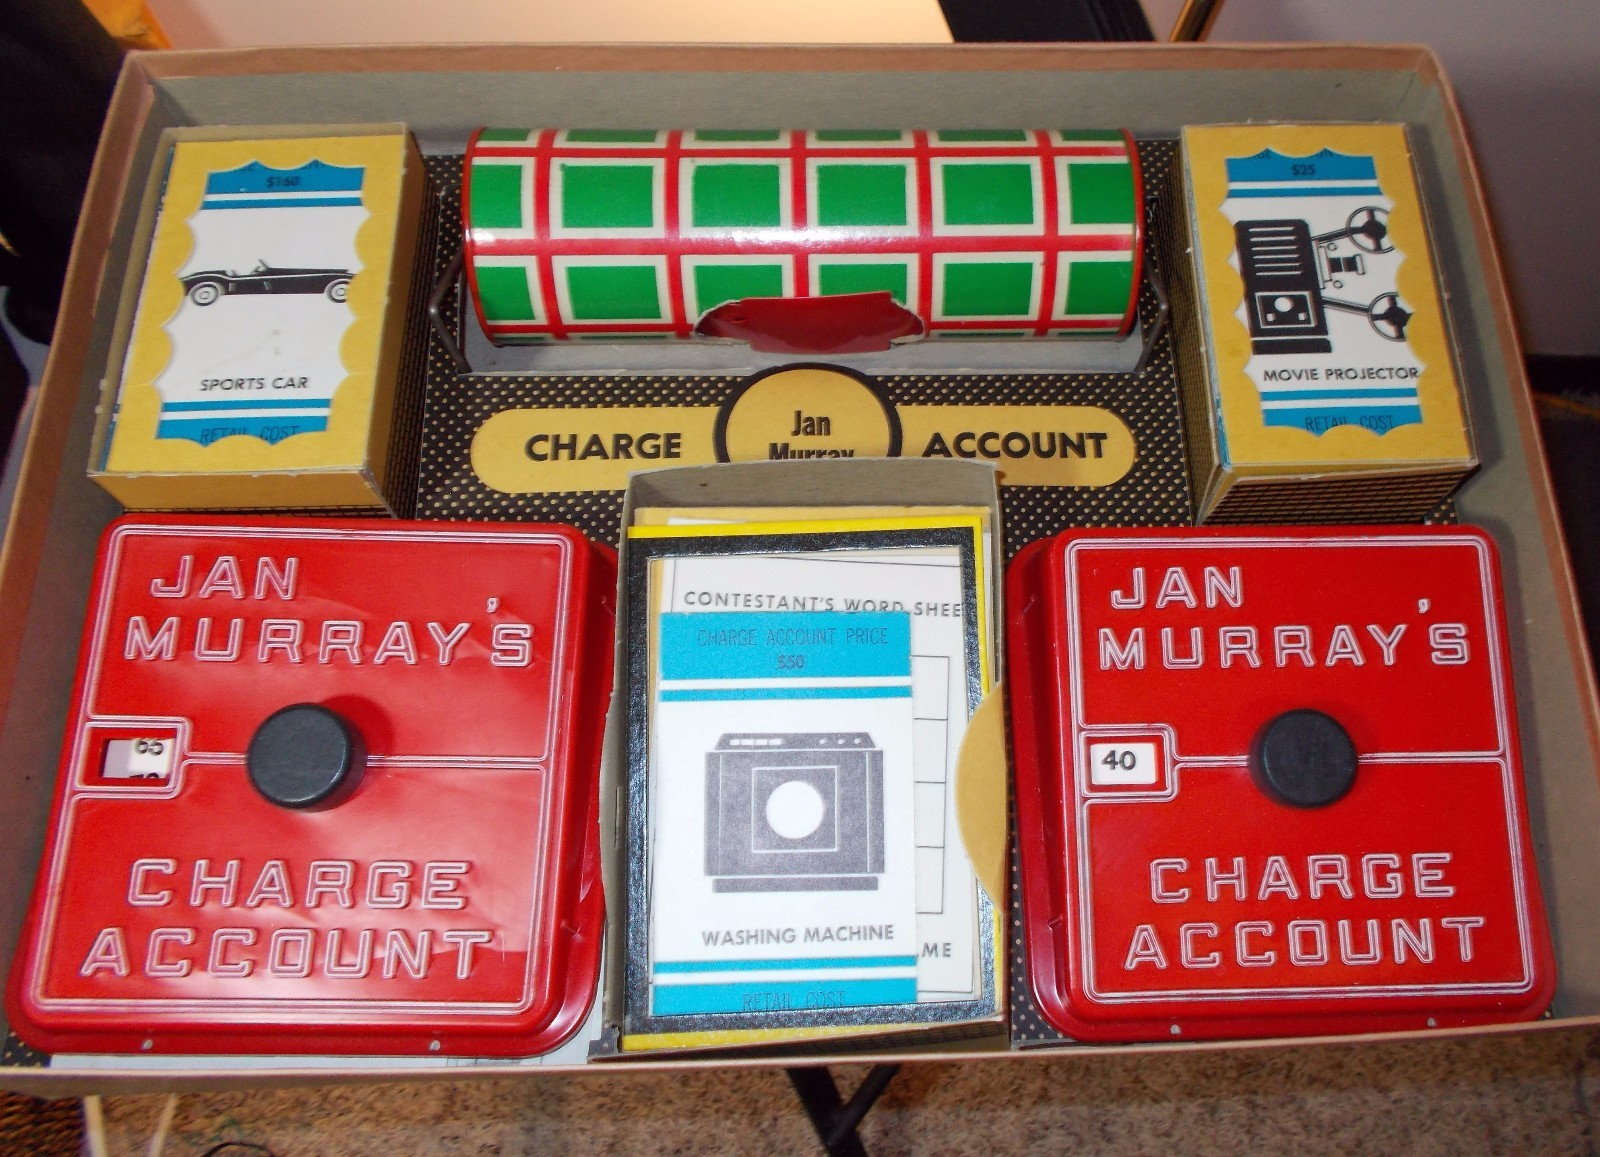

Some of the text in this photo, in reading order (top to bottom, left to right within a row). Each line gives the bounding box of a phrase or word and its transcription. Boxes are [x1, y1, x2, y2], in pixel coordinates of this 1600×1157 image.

[1290, 164, 1316, 177] $25
[199, 375, 310, 393] SPORTS CAR
[1263, 366, 1420, 381] MOVIE PROJECTOR
[791, 410, 831, 437] Jan
[1359, 414, 1394, 430] COST
[524, 431, 682, 462] CHARGE
[923, 430, 1108, 461] ACCOUNT
[149, 554, 300, 602] JAN
[1109, 565, 1244, 610] JAN
[683, 590, 963, 618] CONTESTANT'S WORD SHEE
[122, 595, 536, 670] MURRAY'S
[697, 626, 889, 647] CHARGE ACCOUNT PRICE
[1097, 597, 1471, 671] MURRAY'S
[776, 653, 806, 671] $50
[1101, 749, 1137, 771] 40
[126, 857, 474, 911] CHARGE
[1149, 851, 1457, 905] CHARGE
[701, 923, 895, 947] WASHING MACHINE
[1123, 915, 1487, 971] ACCOUNT
[79, 926, 495, 981] ACCOUNT
[806, 990, 846, 1010] COST
